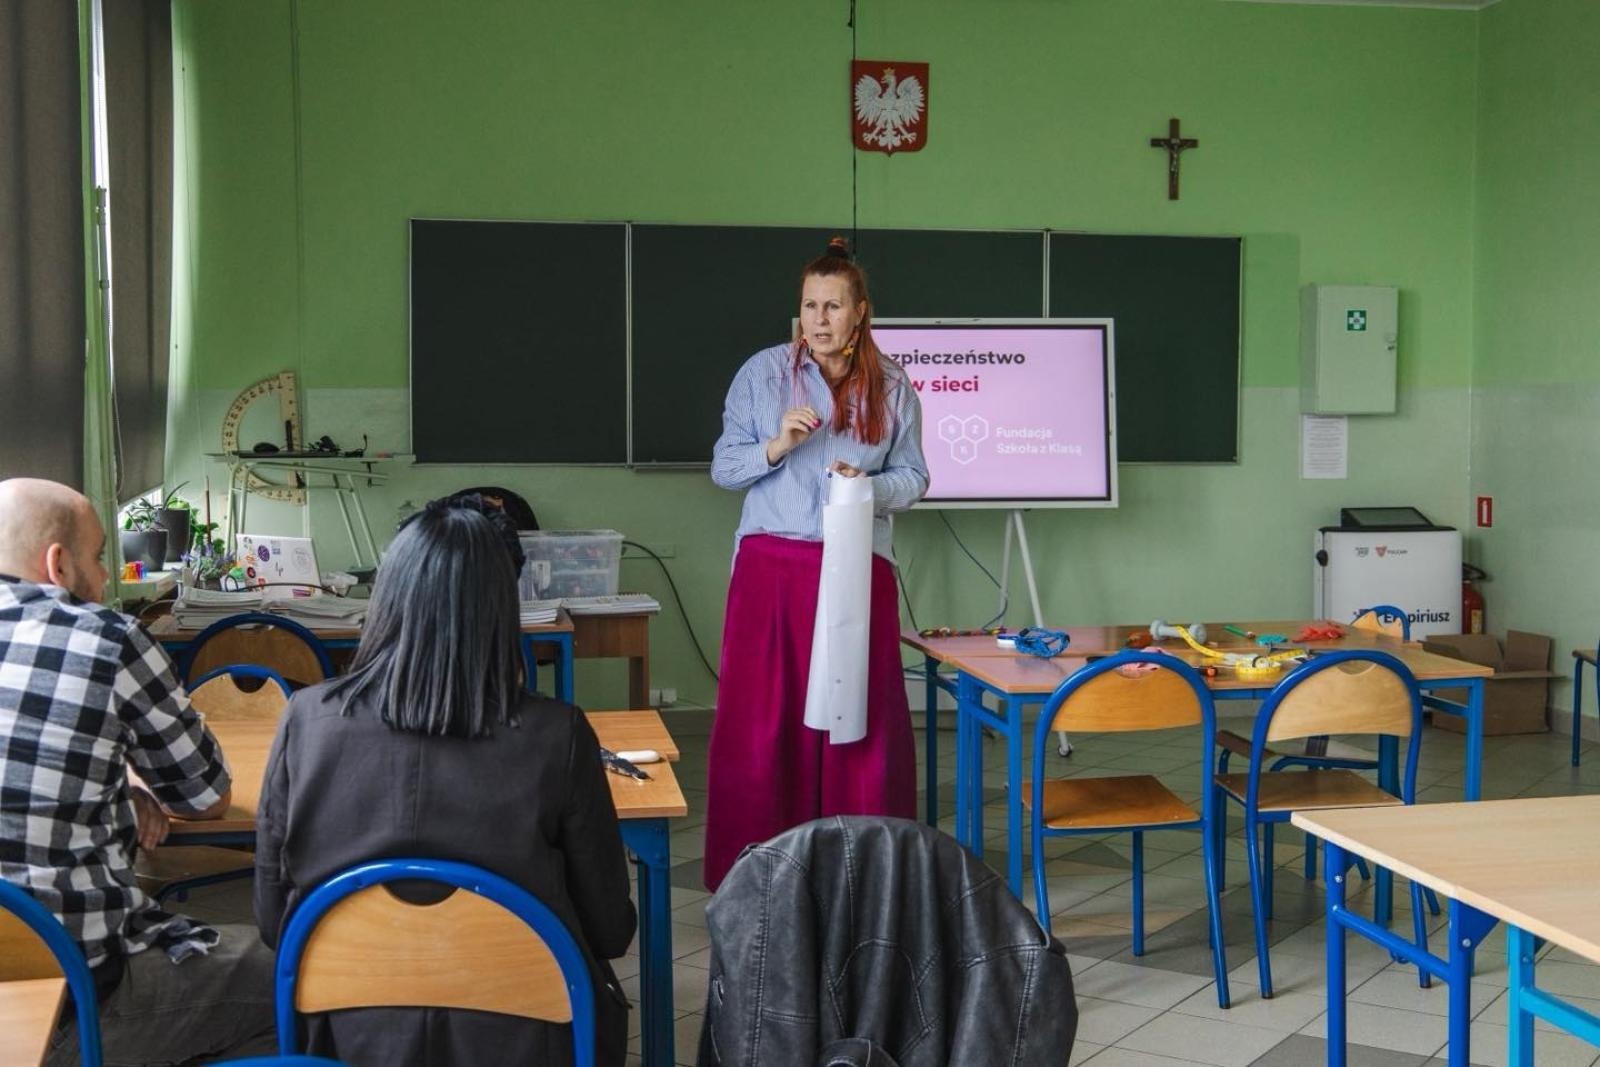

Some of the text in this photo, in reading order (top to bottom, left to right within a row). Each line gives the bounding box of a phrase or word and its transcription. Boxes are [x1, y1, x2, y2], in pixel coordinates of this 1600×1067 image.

[885, 349, 1026, 368] zpieczeństwo
[931, 375, 979, 392] sieci
[996, 426, 1053, 440] Fundacja
[997, 442, 1082, 457] Szkoła z Klasą
[1384, 608, 1451, 626] Epiriusz
